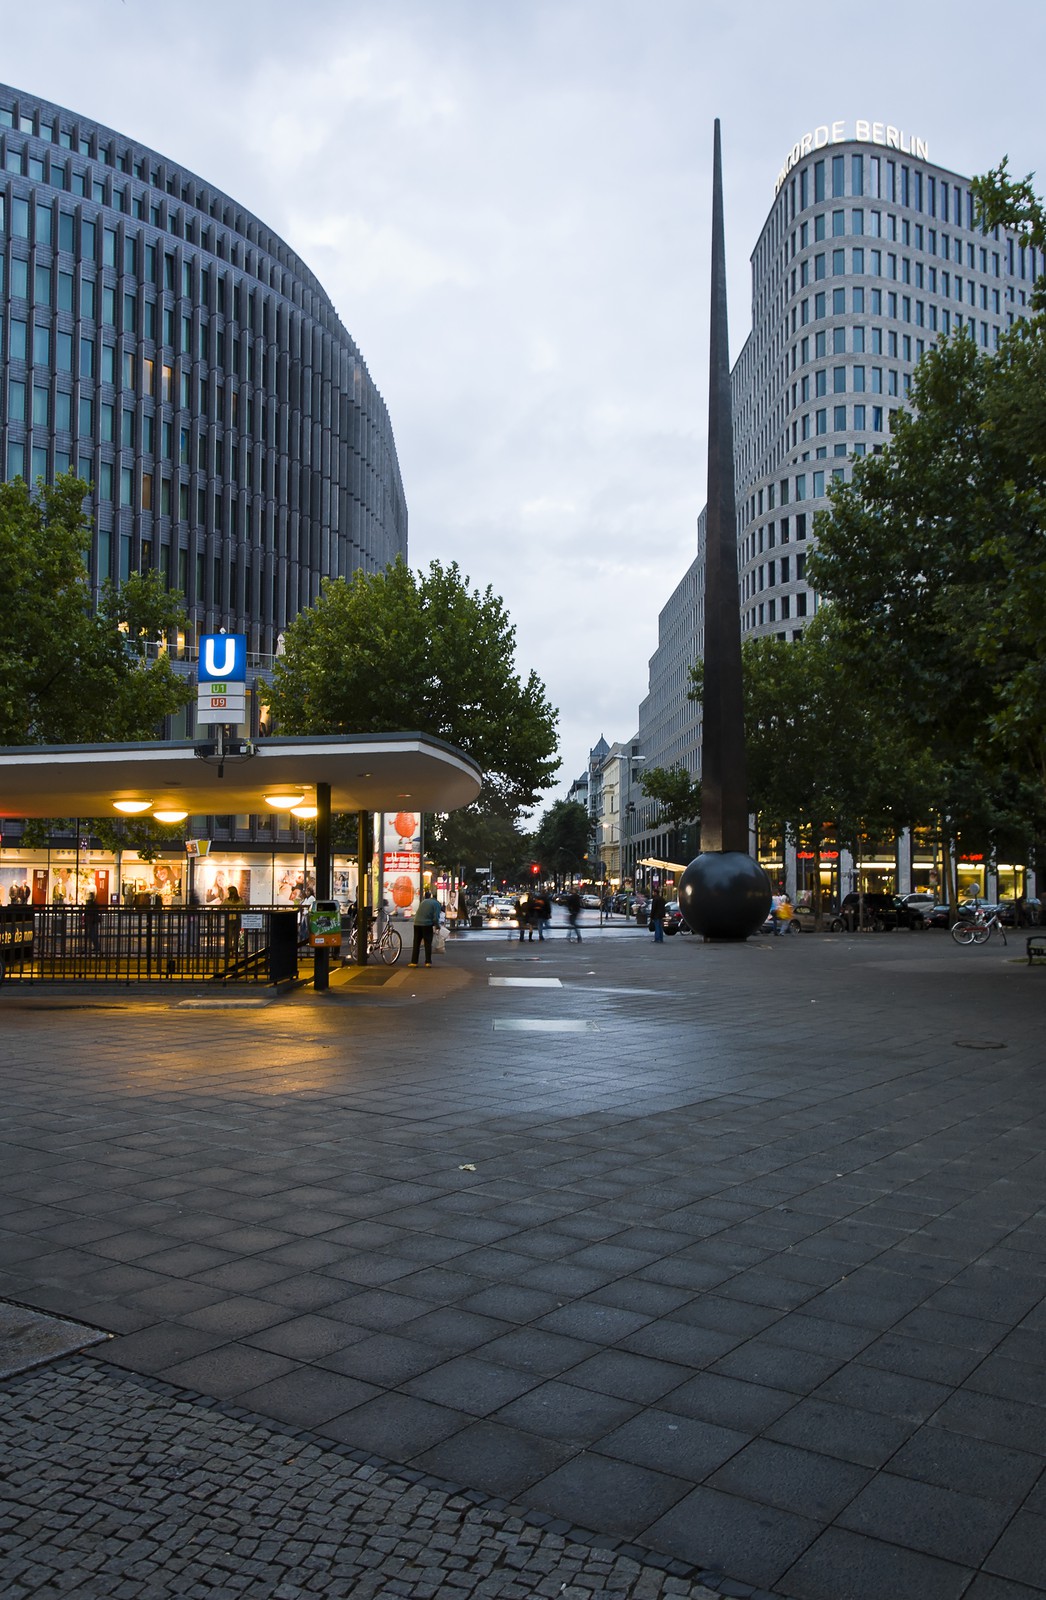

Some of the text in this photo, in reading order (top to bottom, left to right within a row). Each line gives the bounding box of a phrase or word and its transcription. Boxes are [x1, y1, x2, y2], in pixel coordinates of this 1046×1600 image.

[855, 119, 929, 161] BERLIN
[205, 638, 236, 677] U
[212, 684, 225, 693] U1
[212, 699, 225, 707] U9
